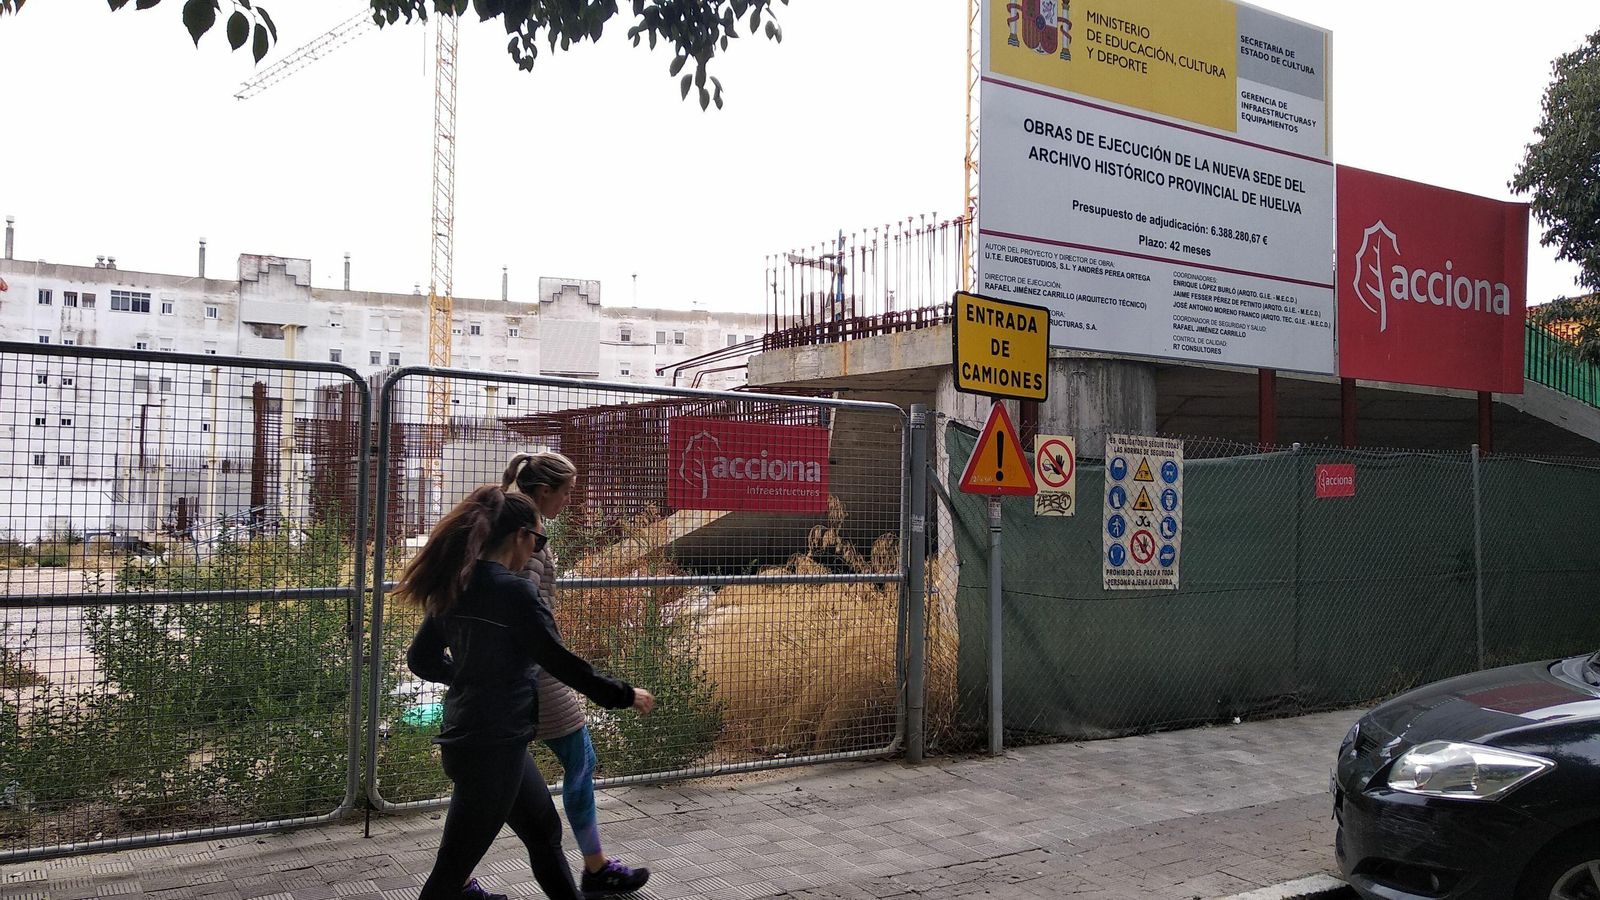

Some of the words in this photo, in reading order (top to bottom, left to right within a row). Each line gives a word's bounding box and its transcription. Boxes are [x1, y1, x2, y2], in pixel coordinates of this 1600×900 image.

[1086, 10, 1151, 39] MINISTERIO
[1086, 28, 1102, 44] DE
[1105, 34, 1177, 66] EDUCACIÓN,
[1178, 55, 1227, 79] CULTURA
[1086, 46, 1094, 59] Y
[1097, 49, 1148, 74] DEPORTE
[1240, 46, 1270, 61] ESTADO
[1270, 55, 1281, 65] DE
[1282, 59, 1316, 75] CULTURA
[1285, 49, 1295, 59] DE
[1241, 91, 1277, 107] GERENCIA
[1278, 101, 1288, 110] DE
[1241, 101, 1312, 127] INFRAESTRUCTURAS
[1241, 112, 1299, 133] EQUIPAMIENTOS
[1023, 118, 1073, 141] OBRAS
[1076, 130, 1095, 147] DE
[1098, 135, 1171, 163] EJECUCIÓN
[1174, 153, 1192, 168] DE
[1194, 158, 1210, 172] LA
[1212, 161, 1251, 181] NUEVA
[1252, 170, 1282, 188] SEDE
[1284, 178, 1306, 193] DEL
[1028, 146, 1092, 171] ARCHIVO
[1095, 161, 1165, 186] HISTÓRICO
[1168, 175, 1239, 203] PROVINCIAL
[1241, 191, 1257, 205] DE
[1259, 194, 1302, 215] HUELVA
[1072, 199, 1133, 221] Presupuesto
[1135, 212, 1147, 223] de
[1149, 214, 1208, 235] adjudicación:
[1210, 225, 1260, 244] 6.388.280,67
[1262, 235, 1268, 245] €
[985, 242, 1007, 252] AUTOR
[1008, 246, 1019, 254] DEL
[1020, 248, 1053, 259] PROYECTO
[1059, 254, 1088, 263] DIRECTOR
[1089, 258, 1097, 266] DE
[1138, 234, 1167, 250] Plazo:
[1169, 240, 1181, 252] 42
[1182, 244, 1212, 257] meses
[985, 252, 1003, 261] U.T.E.
[1005, 254, 1059, 270] EUROESTUDIOS,
[1077, 266, 1103, 276] ANDRÉS
[1104, 269, 1125, 279] PEREA
[1126, 272, 1151, 282] ORTEGA
[1173, 271, 1218, 283] COORDINADORES:
[985, 272, 1016, 283] DIRECTOR
[1017, 276, 1026, 284] DE
[1026, 279, 1063, 289] EJECUCIÓN:
[1173, 279, 1198, 289] ENRIQUE
[1198, 283, 1217, 292] LÓPEZ
[1390, 260, 1511, 316] acciona
[985, 282, 1011, 292] RAFAEL
[1013, 286, 1041, 296] JIMÉNEZ
[1042, 289, 1075, 300] CARRILLO
[1075, 294, 1118, 306] (ARQUITECTO
[1118, 299, 1148, 311] TÉCNICO)
[1173, 290, 1190, 298] JAIME
[1191, 293, 1212, 302] FESSER
[1213, 296, 1231, 305] PÉREZ
[1239, 300, 1262, 309] PETINTO
[966, 303, 1038, 334] ENTRADA
[1173, 301, 1188, 309] JOSÉ
[1188, 303, 1213, 313] ANTONIO
[1213, 307, 1238, 316] MORENO
[1238, 310, 1260, 319] FRANCO
[1085, 322, 1098, 331] S.A.
[1172, 314, 1210, 325] COORDINADOR
[1210, 319, 1218, 327] DE
[1218, 321, 1247, 330] SEGURIDAD
[1172, 322, 1195, 332] RAFAEL
[1195, 326, 1219, 335] JIMÉNEZ
[1219, 328, 1247, 338] CARRILLO
[991, 338, 1010, 358] DE
[1172, 334, 1197, 344] CONTROL
[1197, 337, 1205, 345] DE
[1173, 343, 1181, 351] R7
[1181, 345, 1222, 354] CONSULTORES
[962, 361, 1043, 391] CAMIONES
[711, 449, 821, 482] acciona
[1325, 474, 1352, 487] acciona
[1107, 578, 1131, 586] PERSONA
